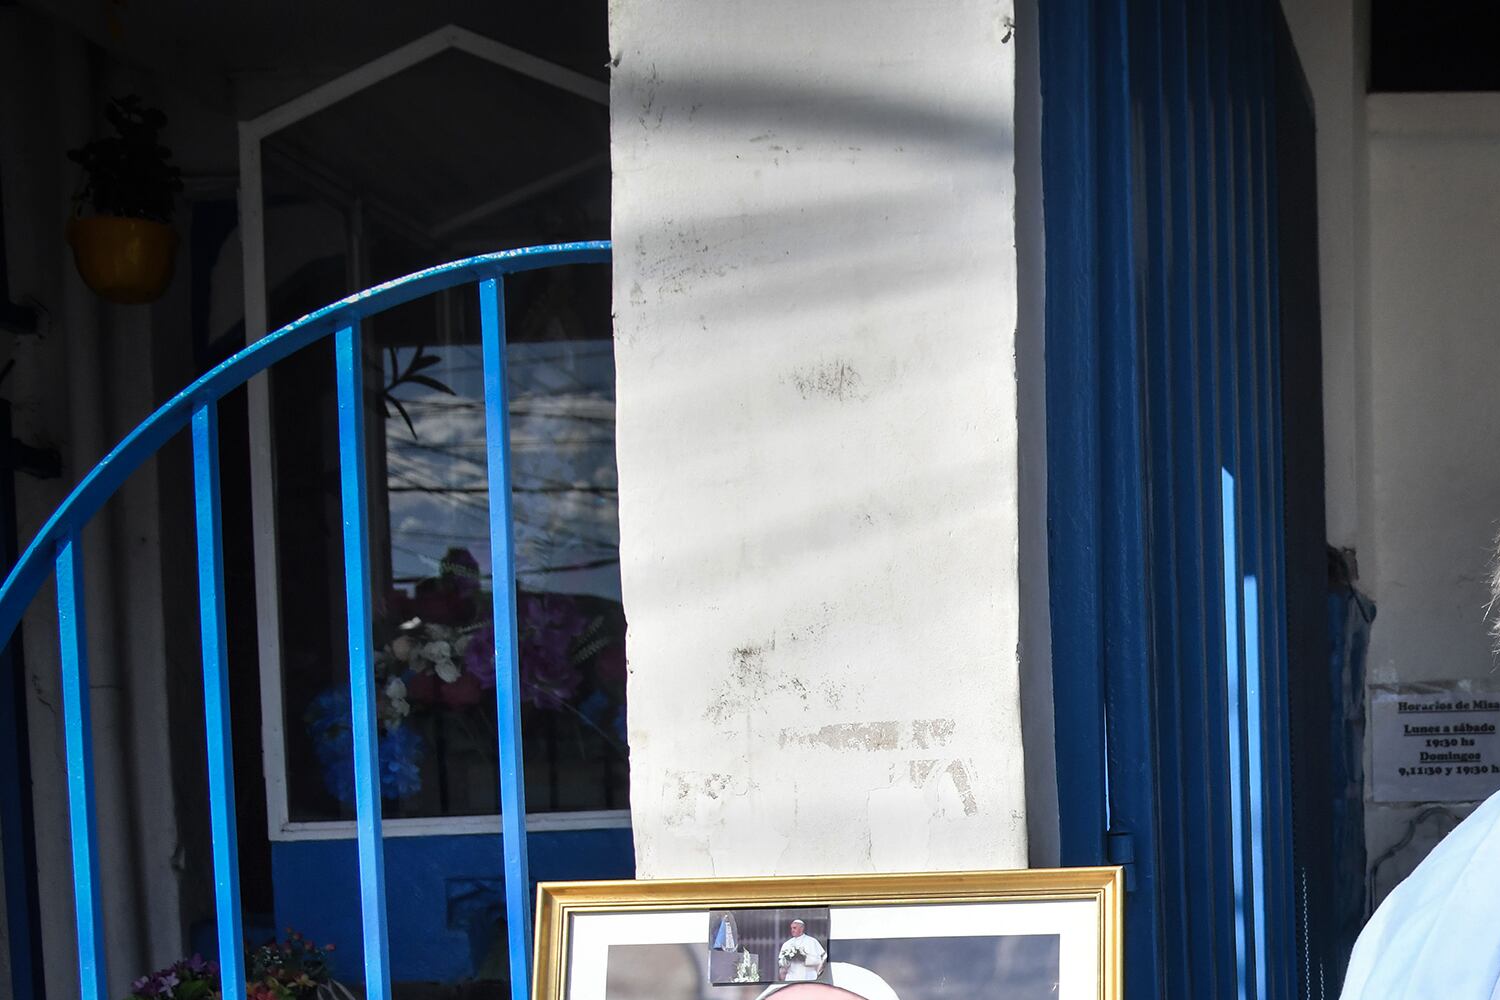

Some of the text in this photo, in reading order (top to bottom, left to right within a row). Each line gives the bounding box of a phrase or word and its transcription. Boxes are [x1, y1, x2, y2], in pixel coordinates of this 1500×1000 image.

[1398, 700, 1500, 712] Horarios de Misa
[1404, 724, 1441, 734] Lunes
[1453, 722, 1496, 733] sábado
[1425, 737, 1476, 748] 19:30 hs
[1420, 751, 1482, 763] Domingos
[1398, 766, 1442, 776] 9,11:30
[1444, 766, 1453, 776] y
[1456, 765, 1489, 775] 19:30
